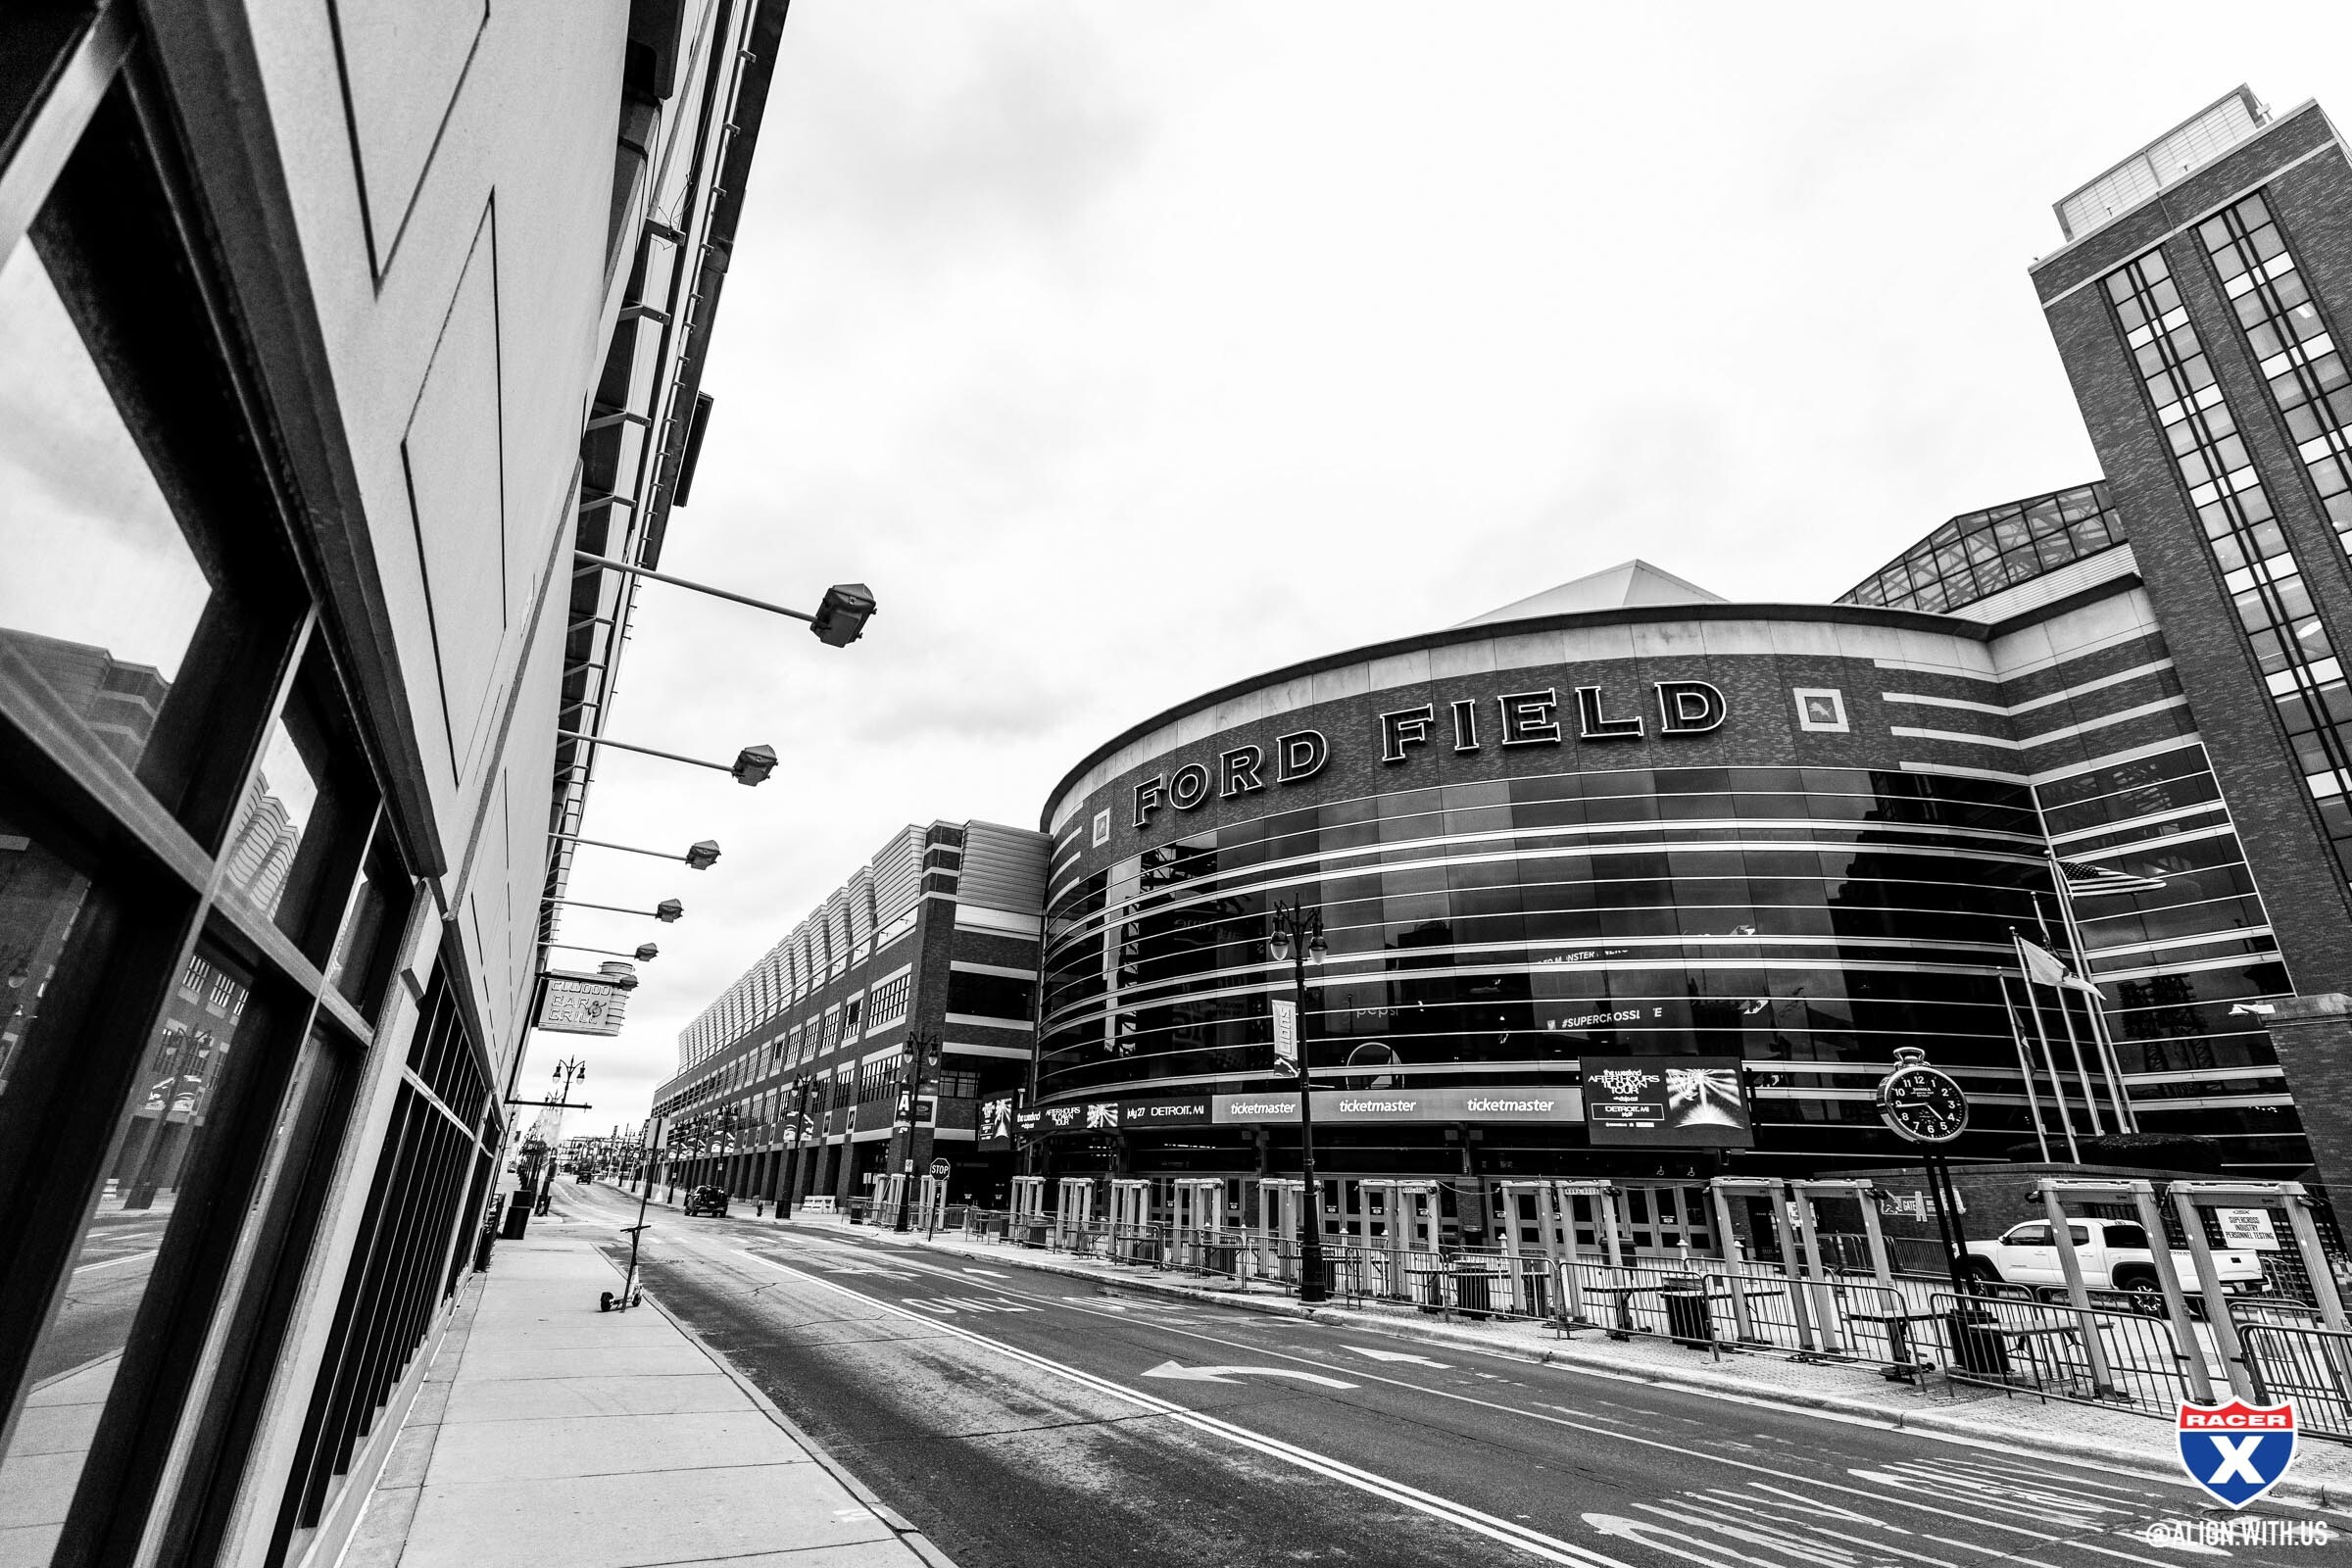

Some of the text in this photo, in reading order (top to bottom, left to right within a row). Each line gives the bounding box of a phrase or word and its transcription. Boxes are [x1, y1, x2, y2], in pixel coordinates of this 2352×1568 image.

[1133, 680, 1728, 828] FORD FIELD
[1555, 952, 1594, 962] MNSTER
[551, 996, 589, 1010] BAR
[549, 1009, 597, 1025] GRILL
[1902, 1079, 1912, 1088] 11
[1914, 1076, 1926, 1085] 12
[1931, 1079, 1936, 1088] 1
[1894, 1088, 1905, 1097] 10
[1941, 1088, 1949, 1097] 2
[1193, 1104, 1204, 1115] MI
[1230, 1102, 1297, 1115] ticketmaster
[1339, 1099, 1417, 1112] ticketmaster
[1467, 1098, 1555, 1112] ticketmaster
[1947, 1100, 1956, 1109] 3
[1137, 1107, 1146, 1117] 27
[1901, 1112, 1910, 1121] 8
[1947, 1112, 1955, 1121] 4
[1913, 1121, 1920, 1130] 7
[1927, 1124, 1935, 1134] 6
[1939, 1121, 1948, 1130] 5
[932, 1164, 949, 1175] STOP
[1902, 1200, 1917, 1211] GATE
[1914, 1191, 1928, 1222] A
[2225, 1231, 2253, 1240] PERSONNEL
[901, 1296, 1046, 1314] ONLY
